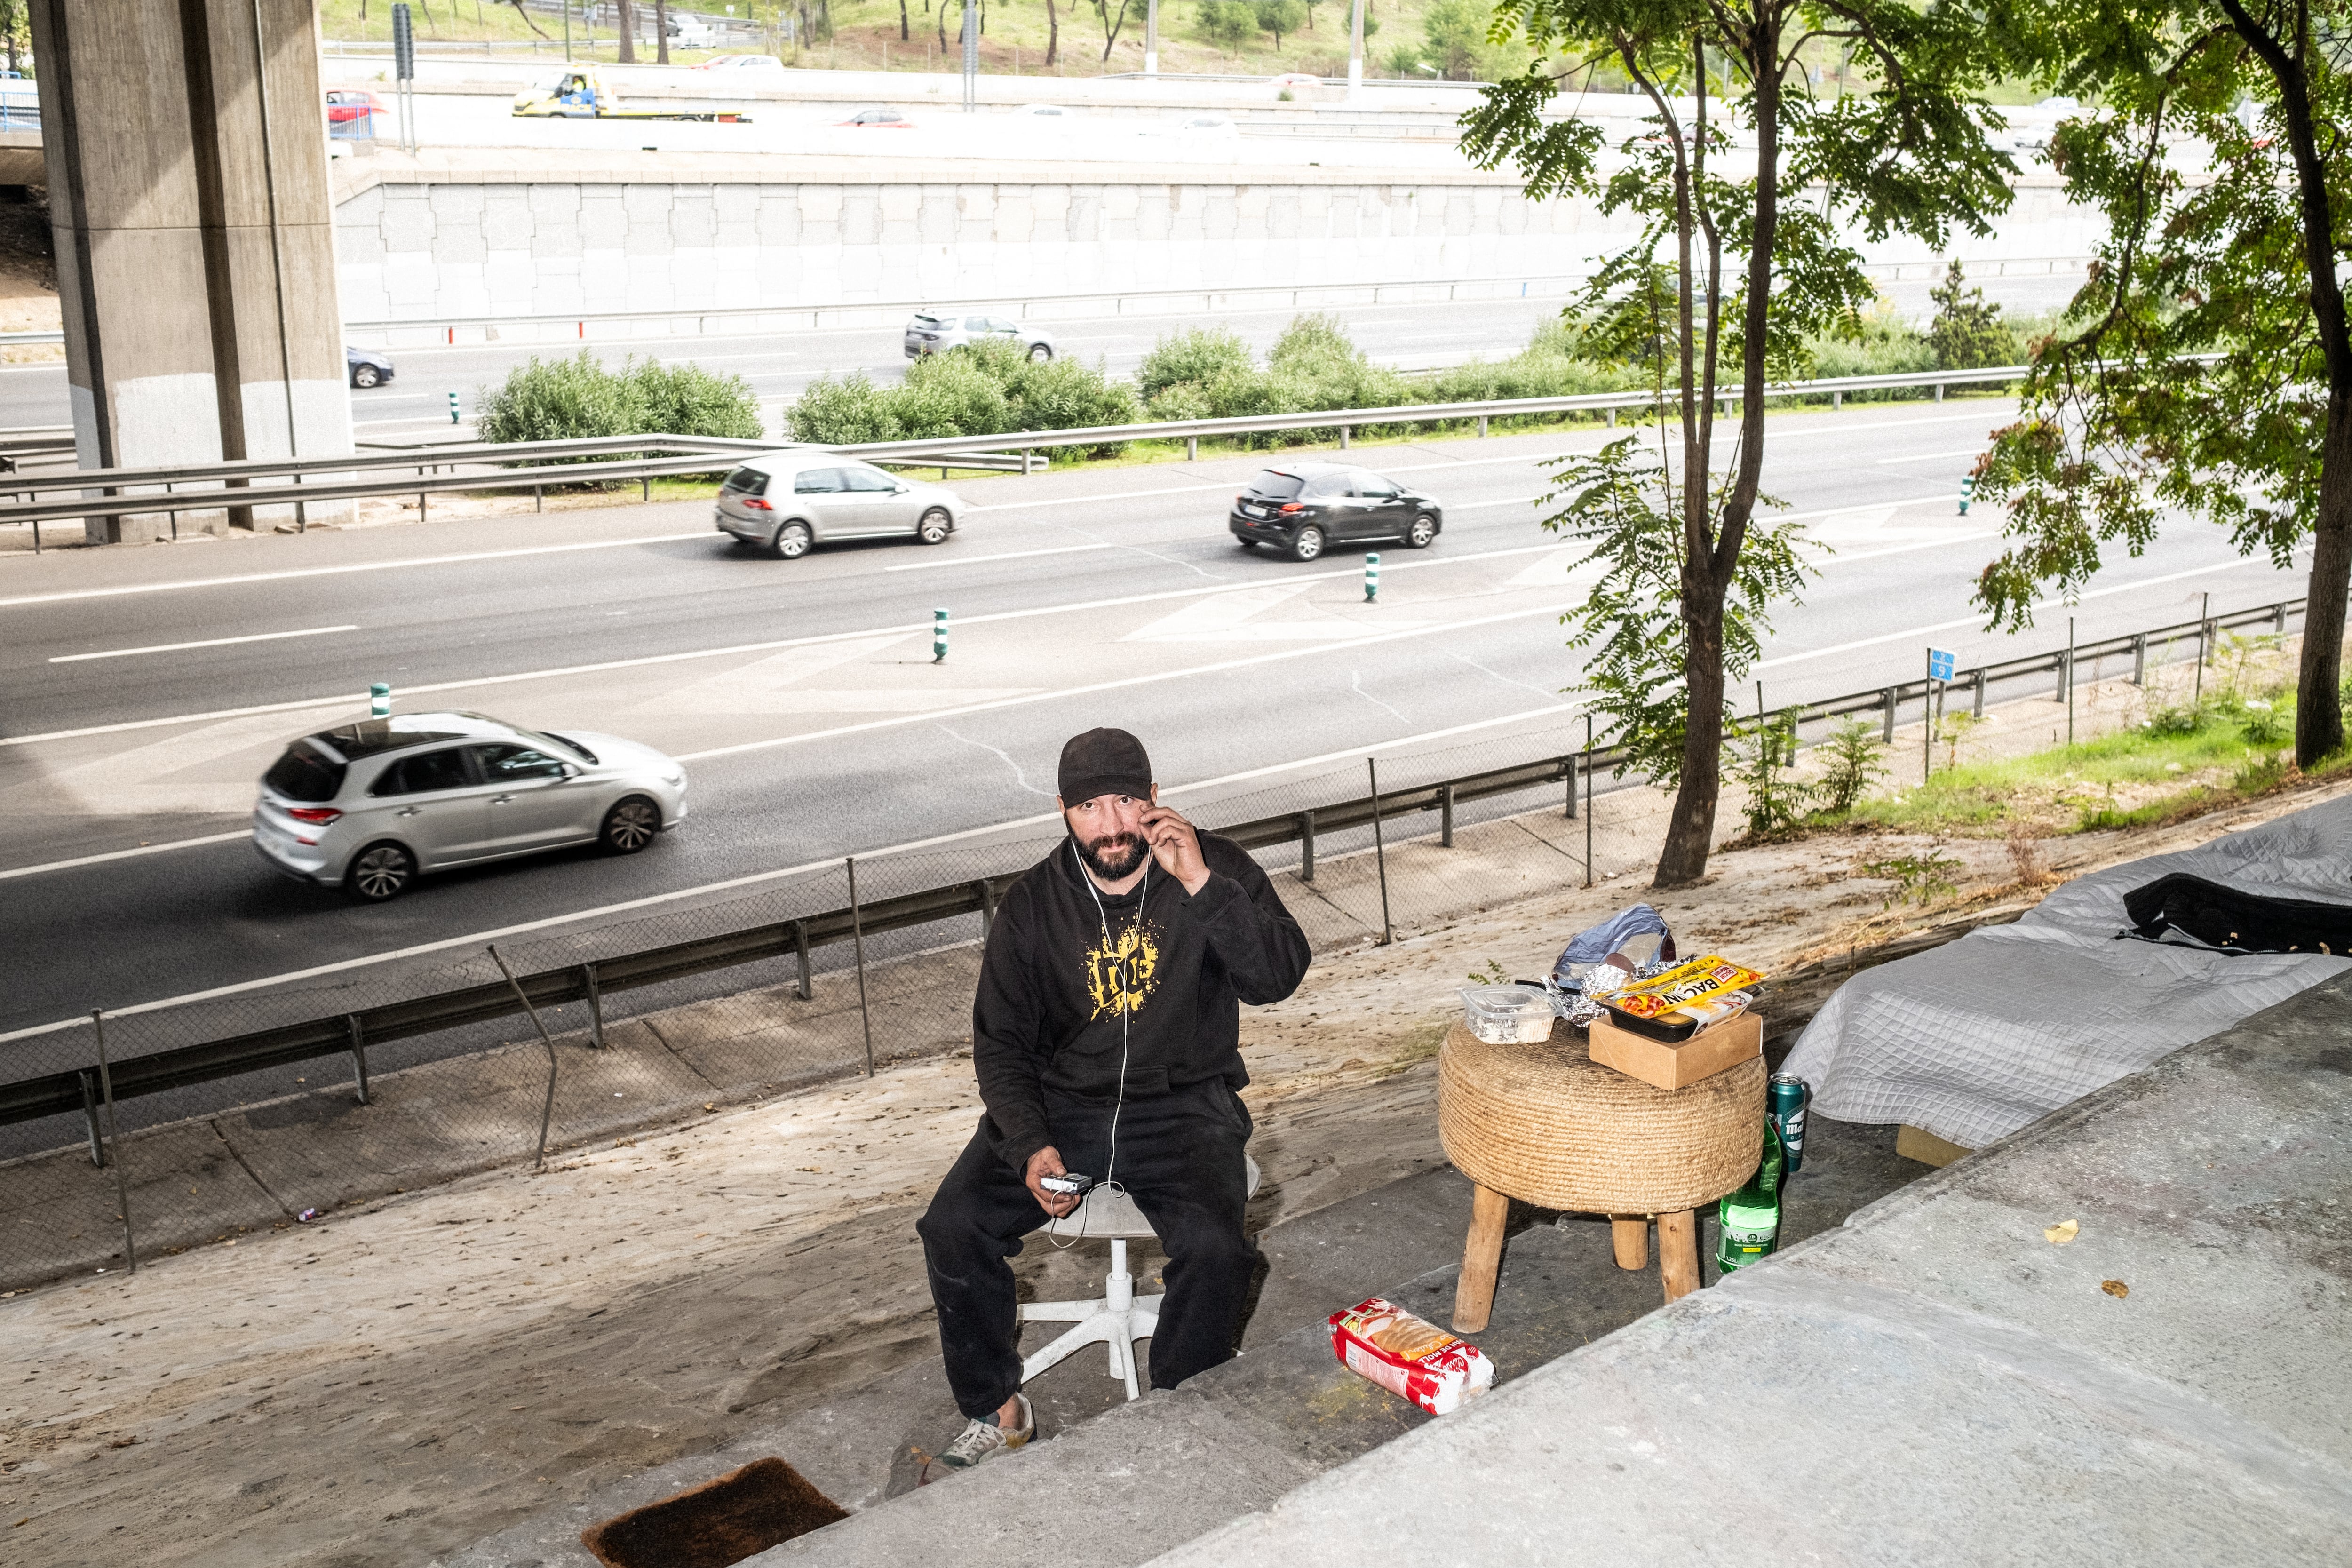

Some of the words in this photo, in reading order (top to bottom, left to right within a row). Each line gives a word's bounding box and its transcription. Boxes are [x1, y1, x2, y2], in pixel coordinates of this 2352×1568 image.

[1939, 665, 1945, 677] 9
[1714, 966, 1730, 976] Mayer
[1720, 970, 1735, 980] Oscar
[1662, 978, 1720, 1005] BACN
[1449, 1339, 1464, 1347] PAN
